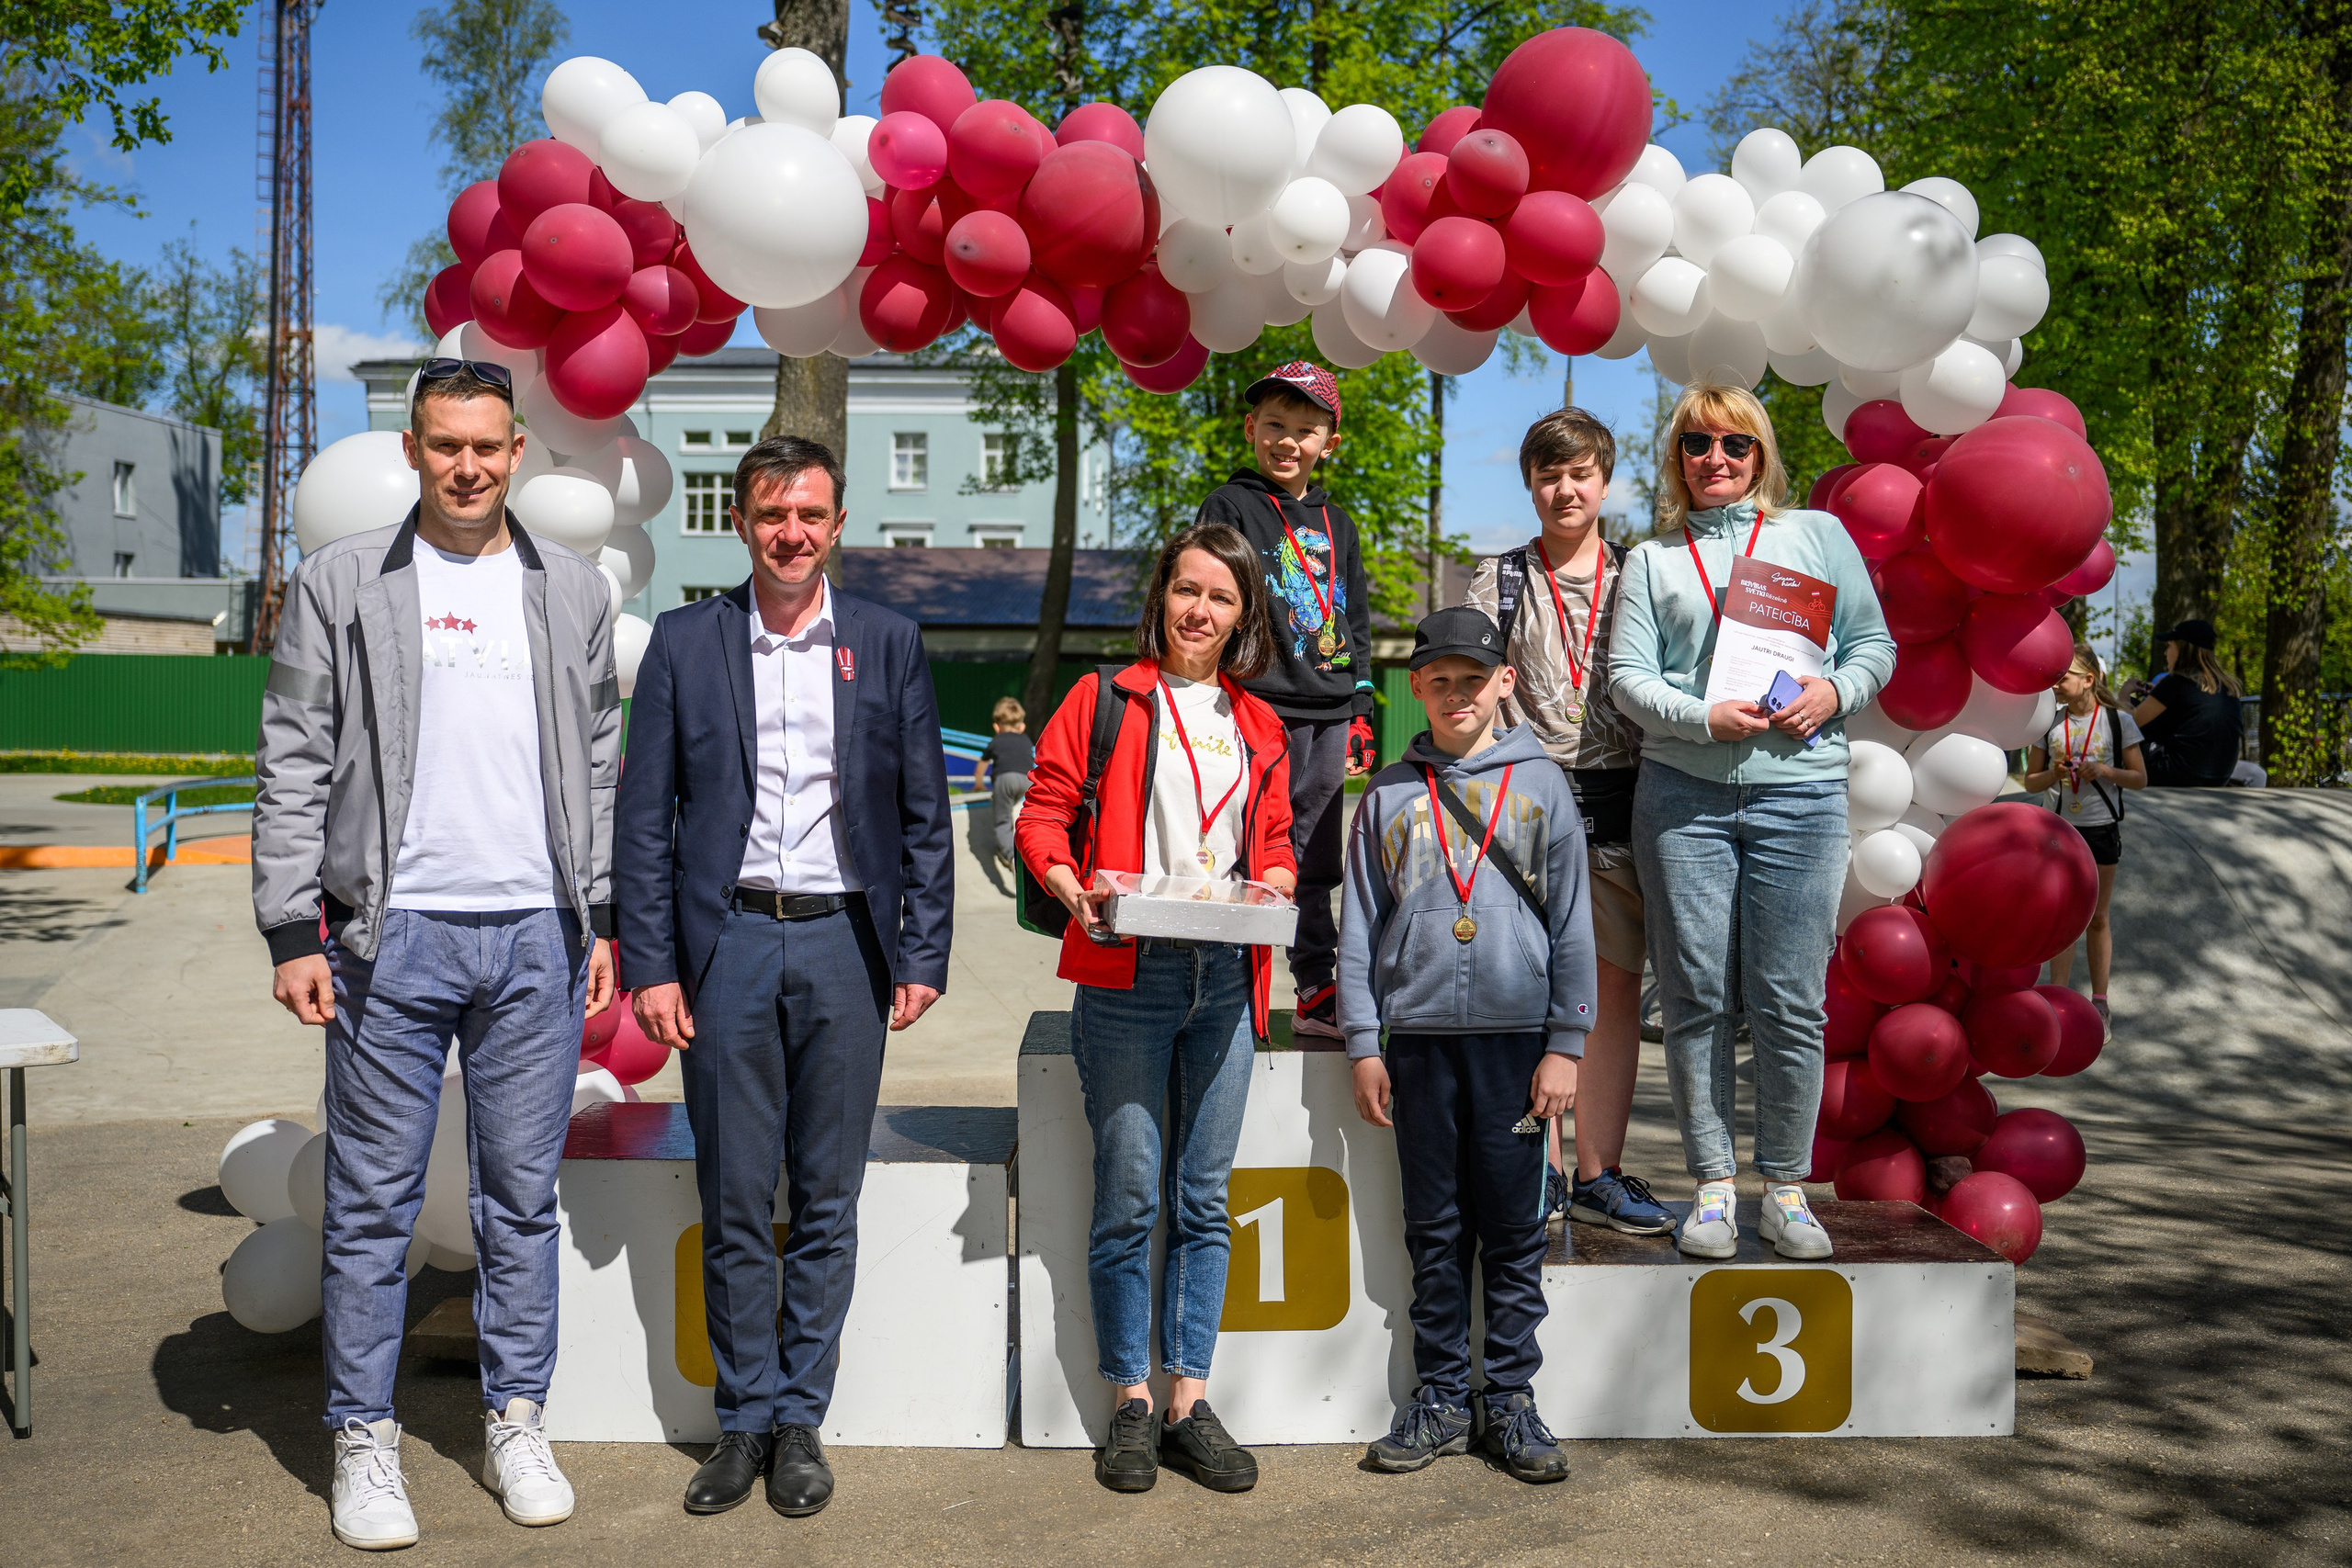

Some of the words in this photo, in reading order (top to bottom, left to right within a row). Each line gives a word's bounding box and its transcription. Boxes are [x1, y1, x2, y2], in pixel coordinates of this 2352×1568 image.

[1749, 602, 1810, 630] PATEICĪBA
[1751, 645, 1772, 655] JAUTRI
[1772, 650, 1795, 662] DRAUGI
[1511, 1125, 1541, 1134] adidas
[1235, 1196, 1285, 1303] 1
[1736, 1296, 1806, 1404] 3
